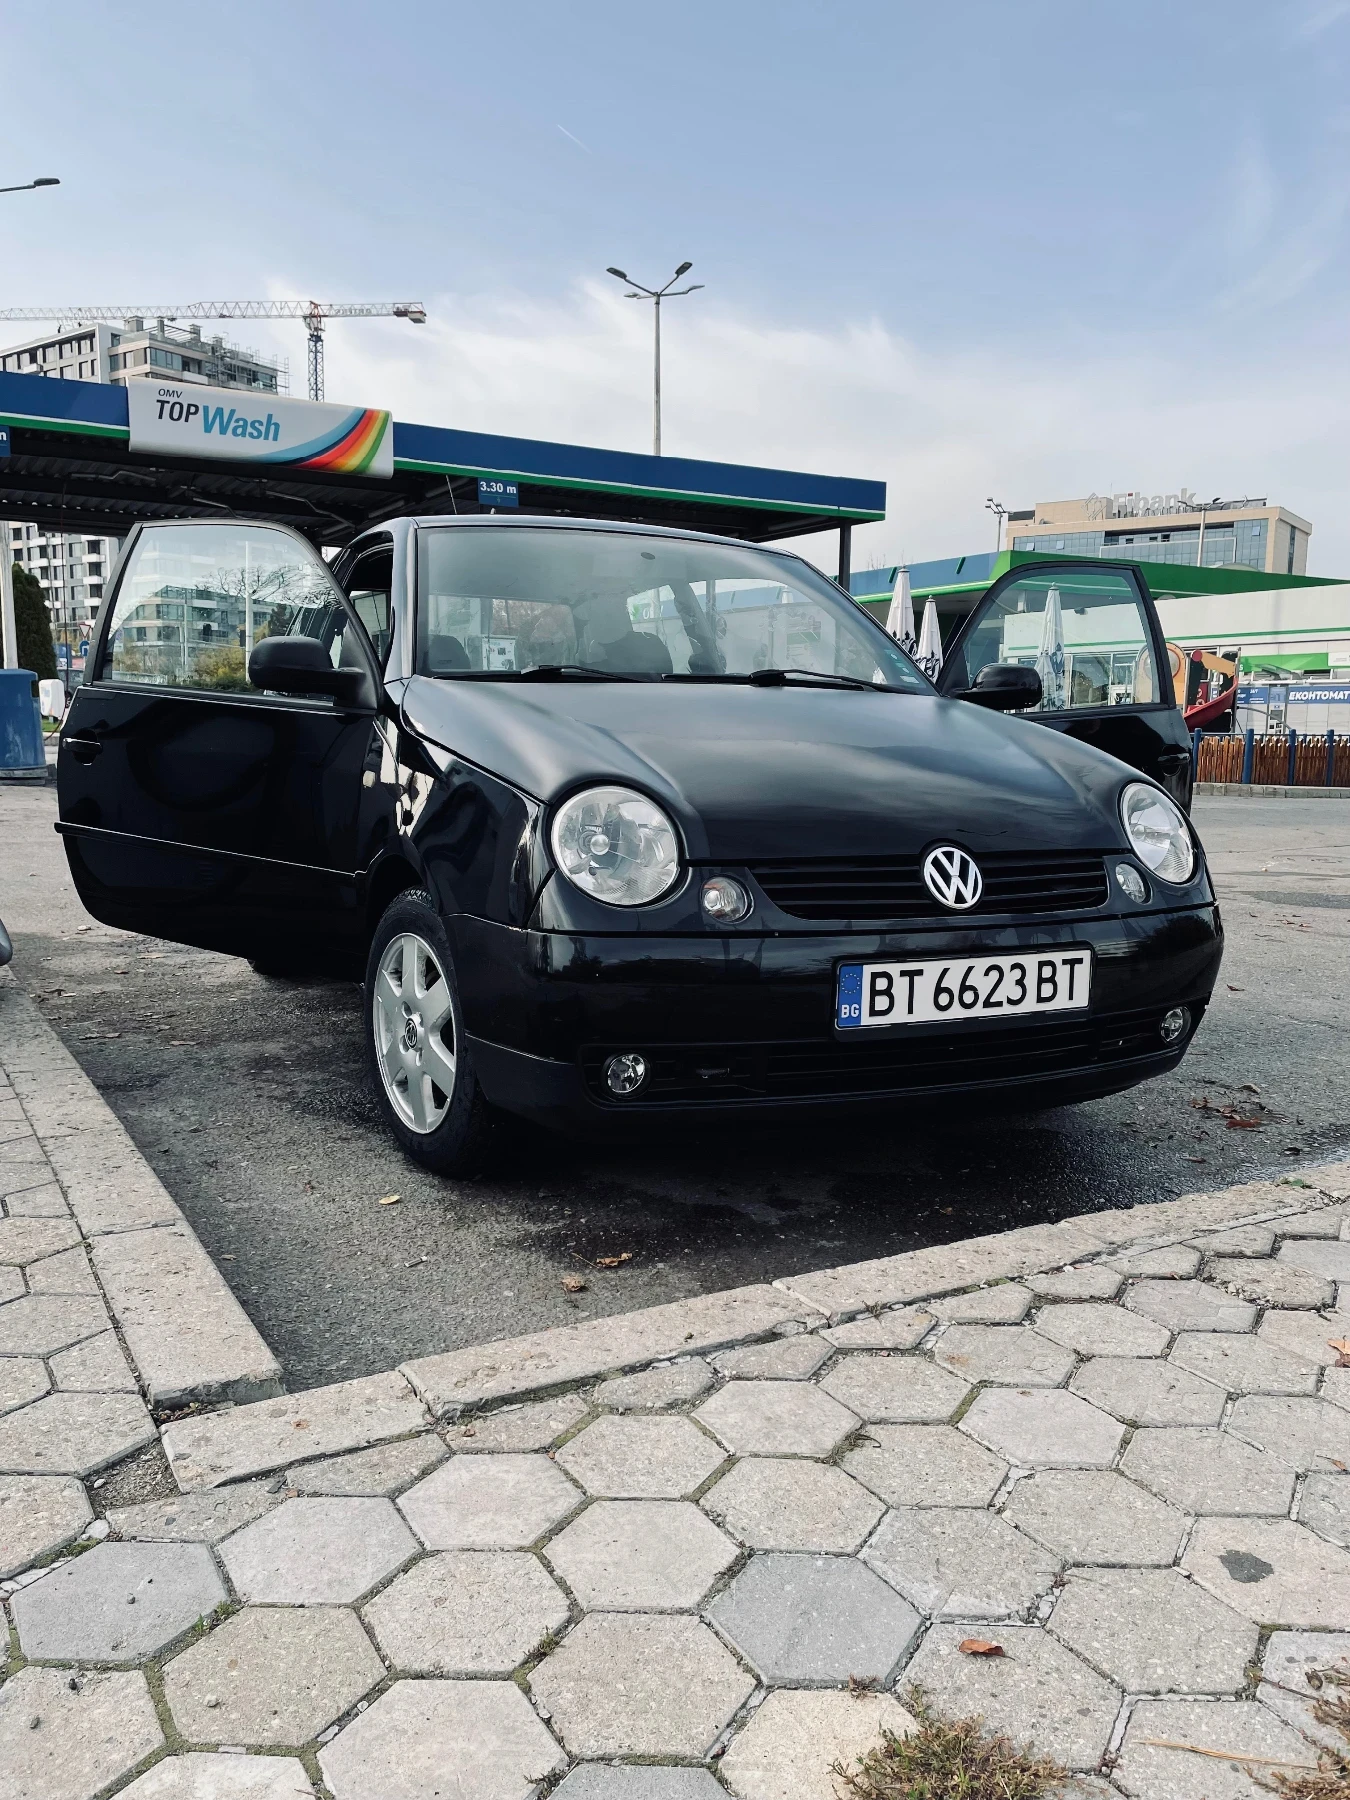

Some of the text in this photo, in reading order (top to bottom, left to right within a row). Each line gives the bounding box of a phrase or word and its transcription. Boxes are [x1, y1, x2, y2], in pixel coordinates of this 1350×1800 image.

[158, 388, 183, 399] OMV
[156, 399, 280, 442] TOP Wash
[480, 481, 517, 494] 3.30 m
[1112, 487, 1197, 512] Fibank
[1288, 690, 1350, 701] ЕКОНТОМАТ
[868, 958, 1084, 1018] BT 6623 BT
[840, 1004, 859, 1019] BG
